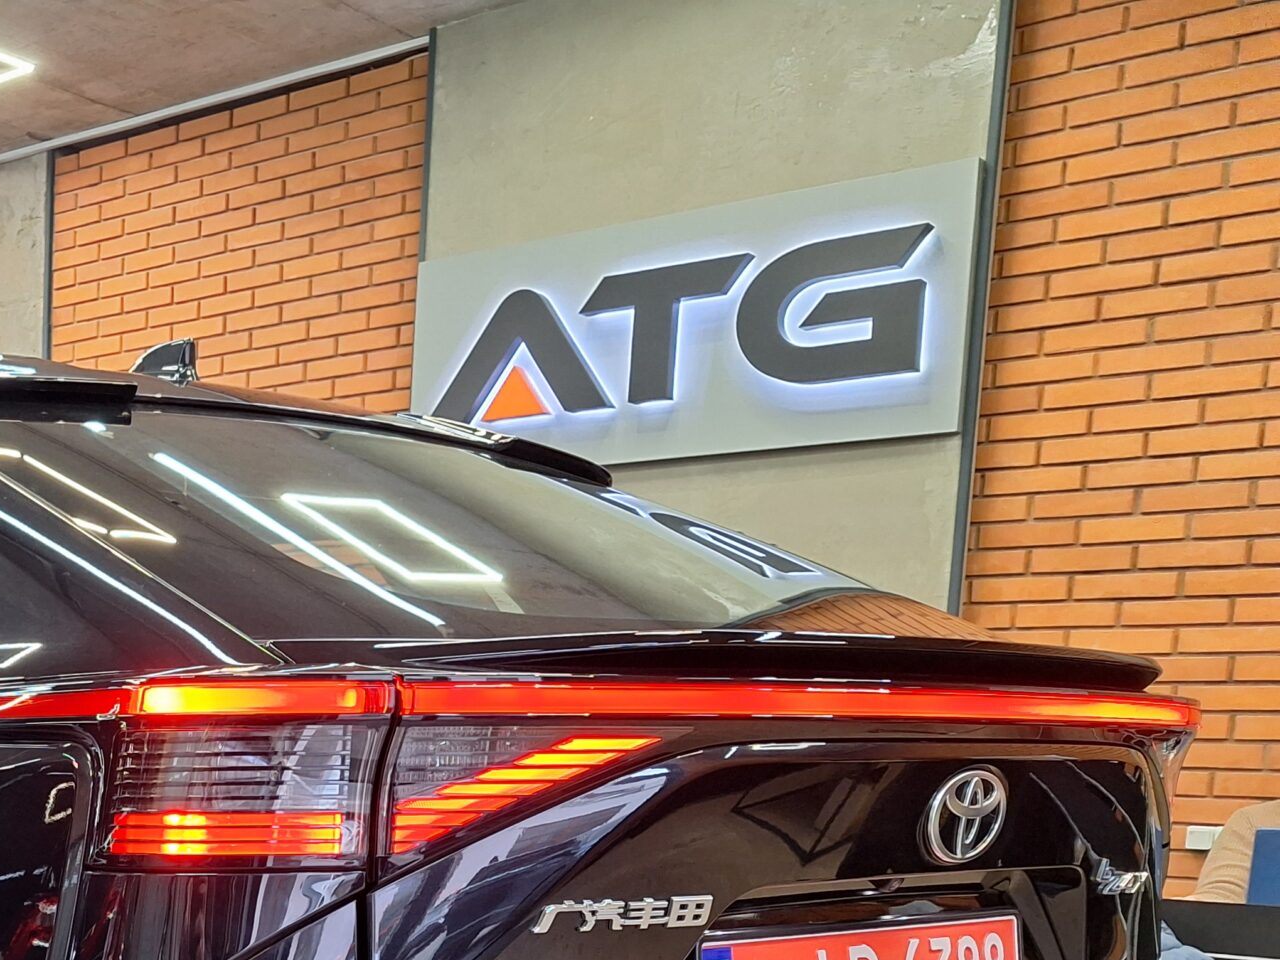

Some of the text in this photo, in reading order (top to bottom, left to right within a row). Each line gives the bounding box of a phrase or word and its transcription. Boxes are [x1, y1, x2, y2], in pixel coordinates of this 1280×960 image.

[431, 222, 935, 423] ATG
[531, 894, 714, 934] 广汽丰田
